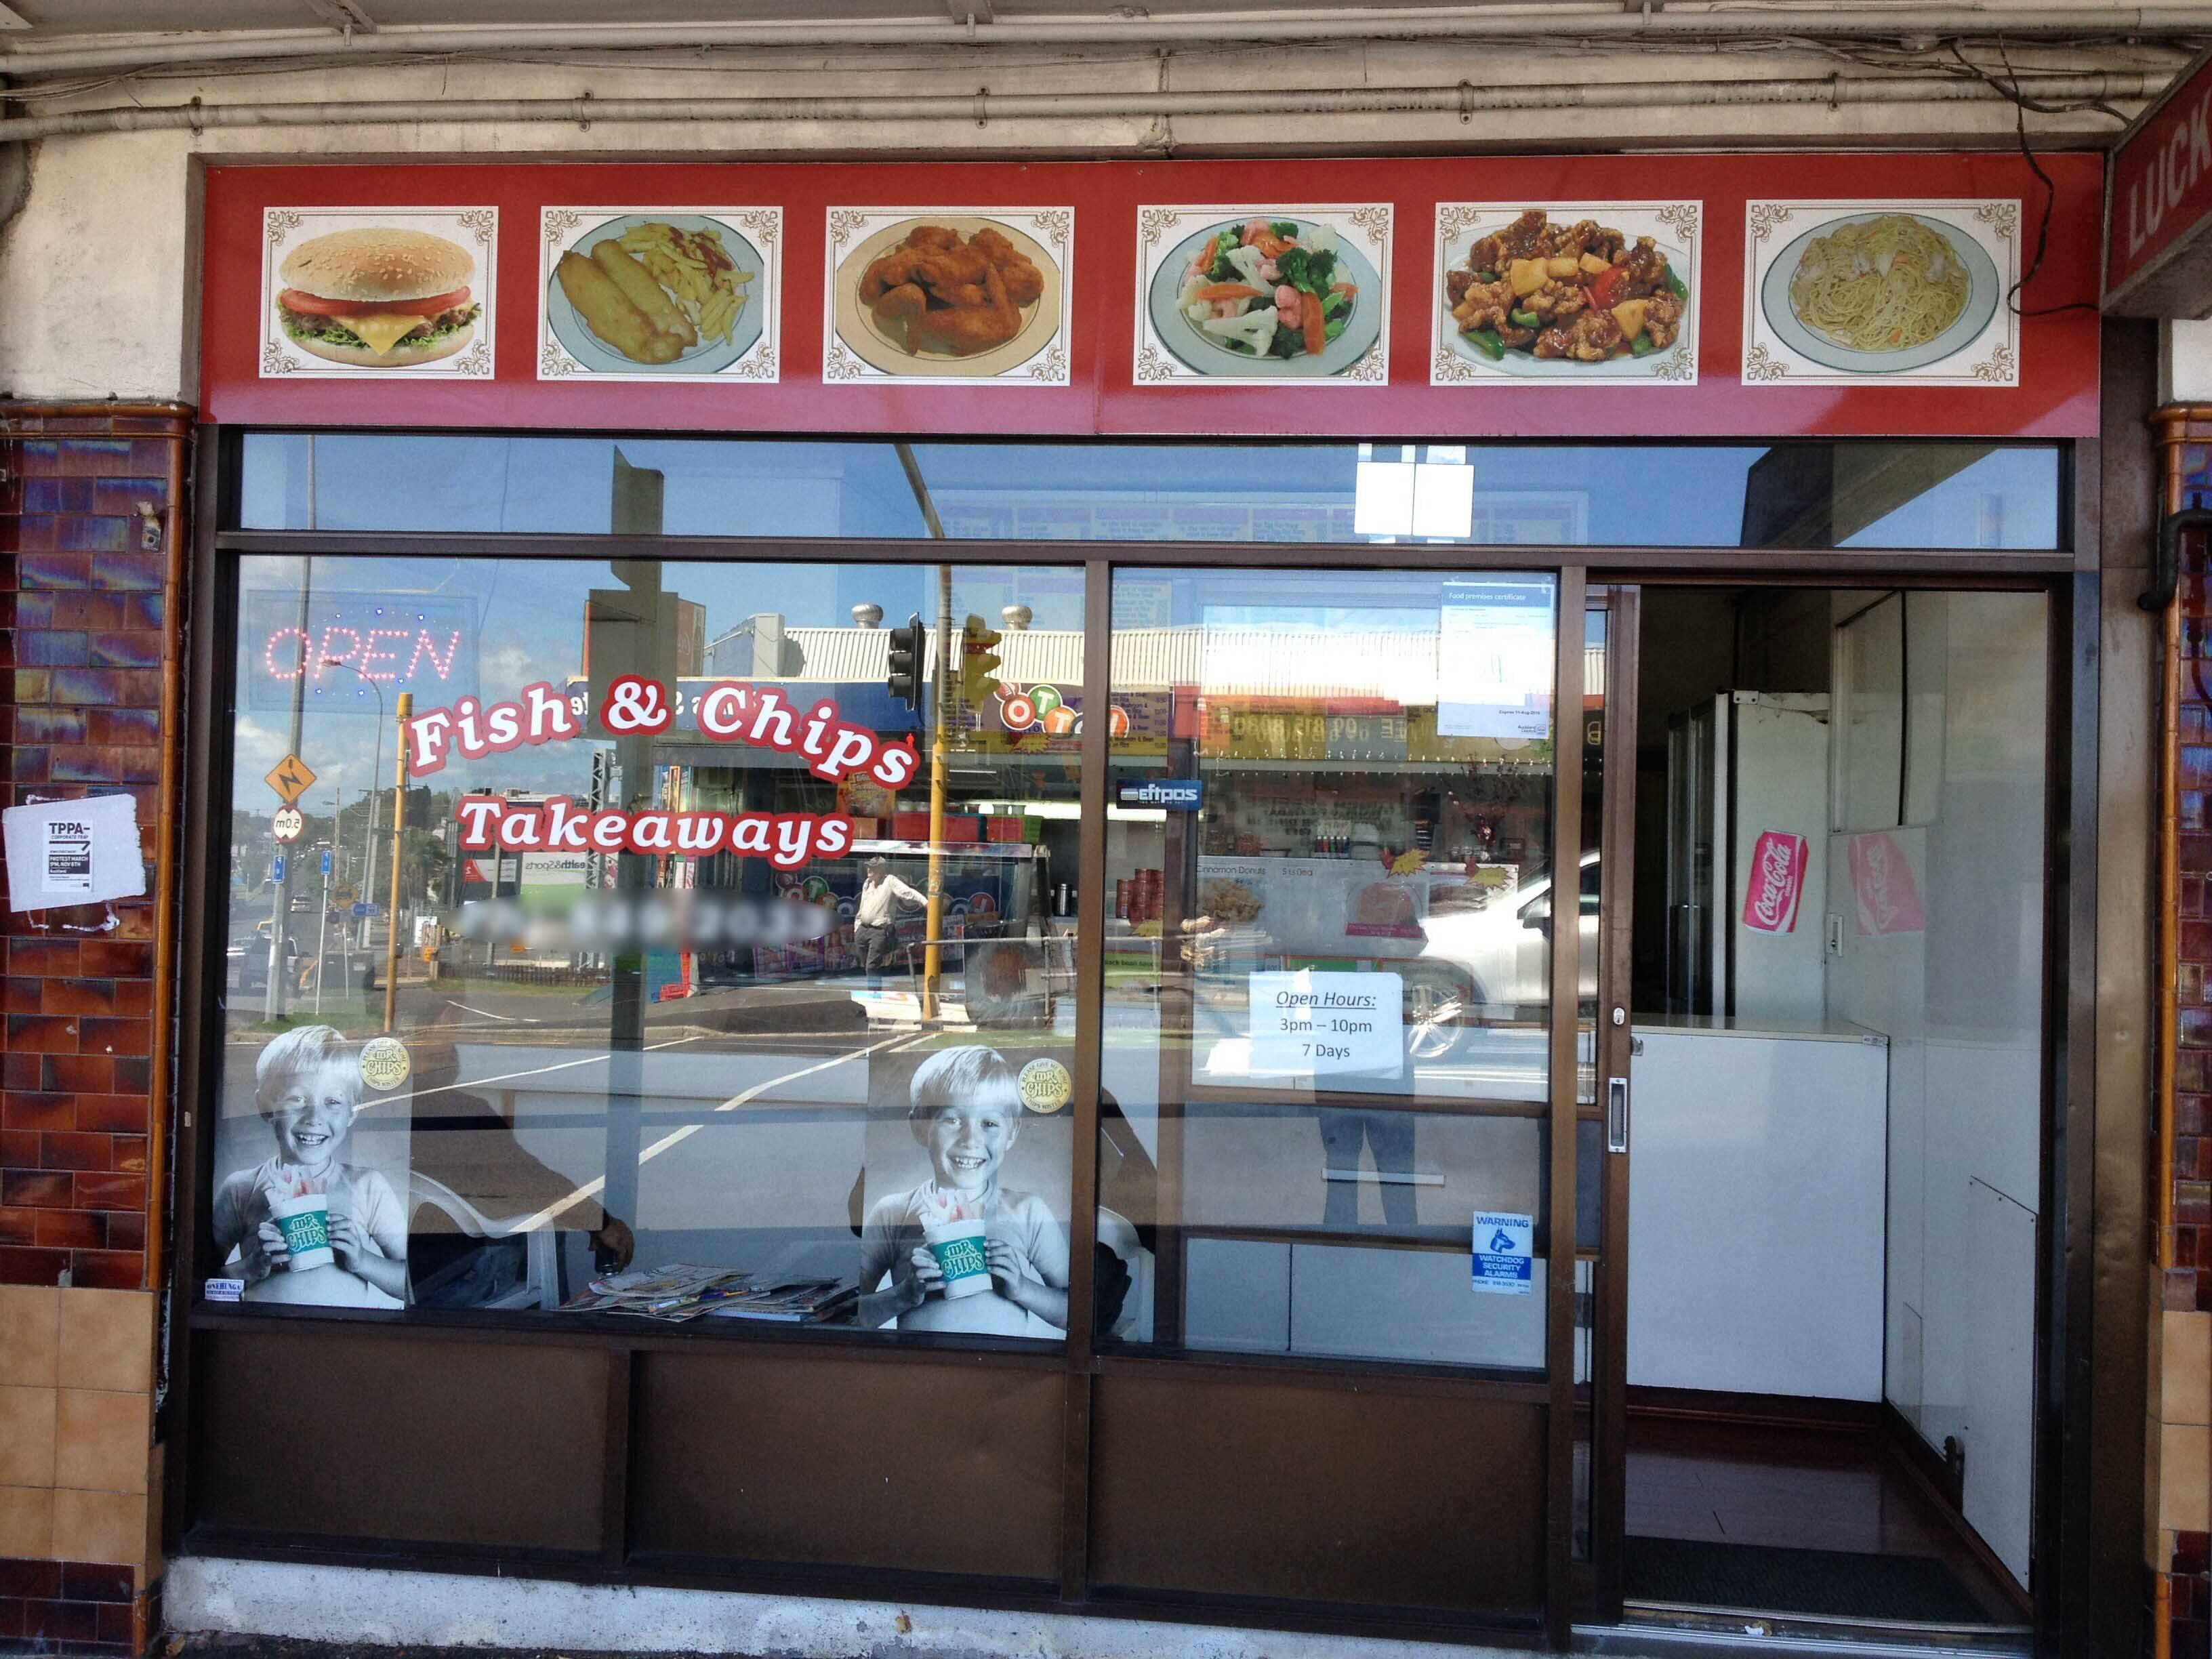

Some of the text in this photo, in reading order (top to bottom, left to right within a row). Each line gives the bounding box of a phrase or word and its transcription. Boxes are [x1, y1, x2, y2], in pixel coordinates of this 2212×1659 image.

[1465, 593, 1493, 601] premises
[1494, 593, 1526, 601] certificate
[265, 626, 460, 680] OPEN
[411, 686, 571, 768] Fish
[608, 681, 668, 730] &
[702, 687, 914, 784] Chips
[1139, 783, 1197, 803] eftpos
[461, 801, 850, 865] Takeaways
[1277, 991, 1376, 1008] Open Hours:
[1279, 1018, 1312, 1033] 3pm
[1331, 1019, 1372, 1034] 10pm
[1302, 1044, 1350, 1060] 7 Days
[367, 1061, 401, 1076] CHIPS
[1025, 1082, 1063, 1098] CHIPS
[1476, 1216, 1530, 1228] WARNING
[286, 1226, 327, 1252] CHIPS
[941, 1252, 985, 1279] CHIPS
[1479, 1254, 1525, 1265] WATCHDOG
[1482, 1262, 1522, 1271] SECURITY
[1484, 1269, 1519, 1279] ALARMS
